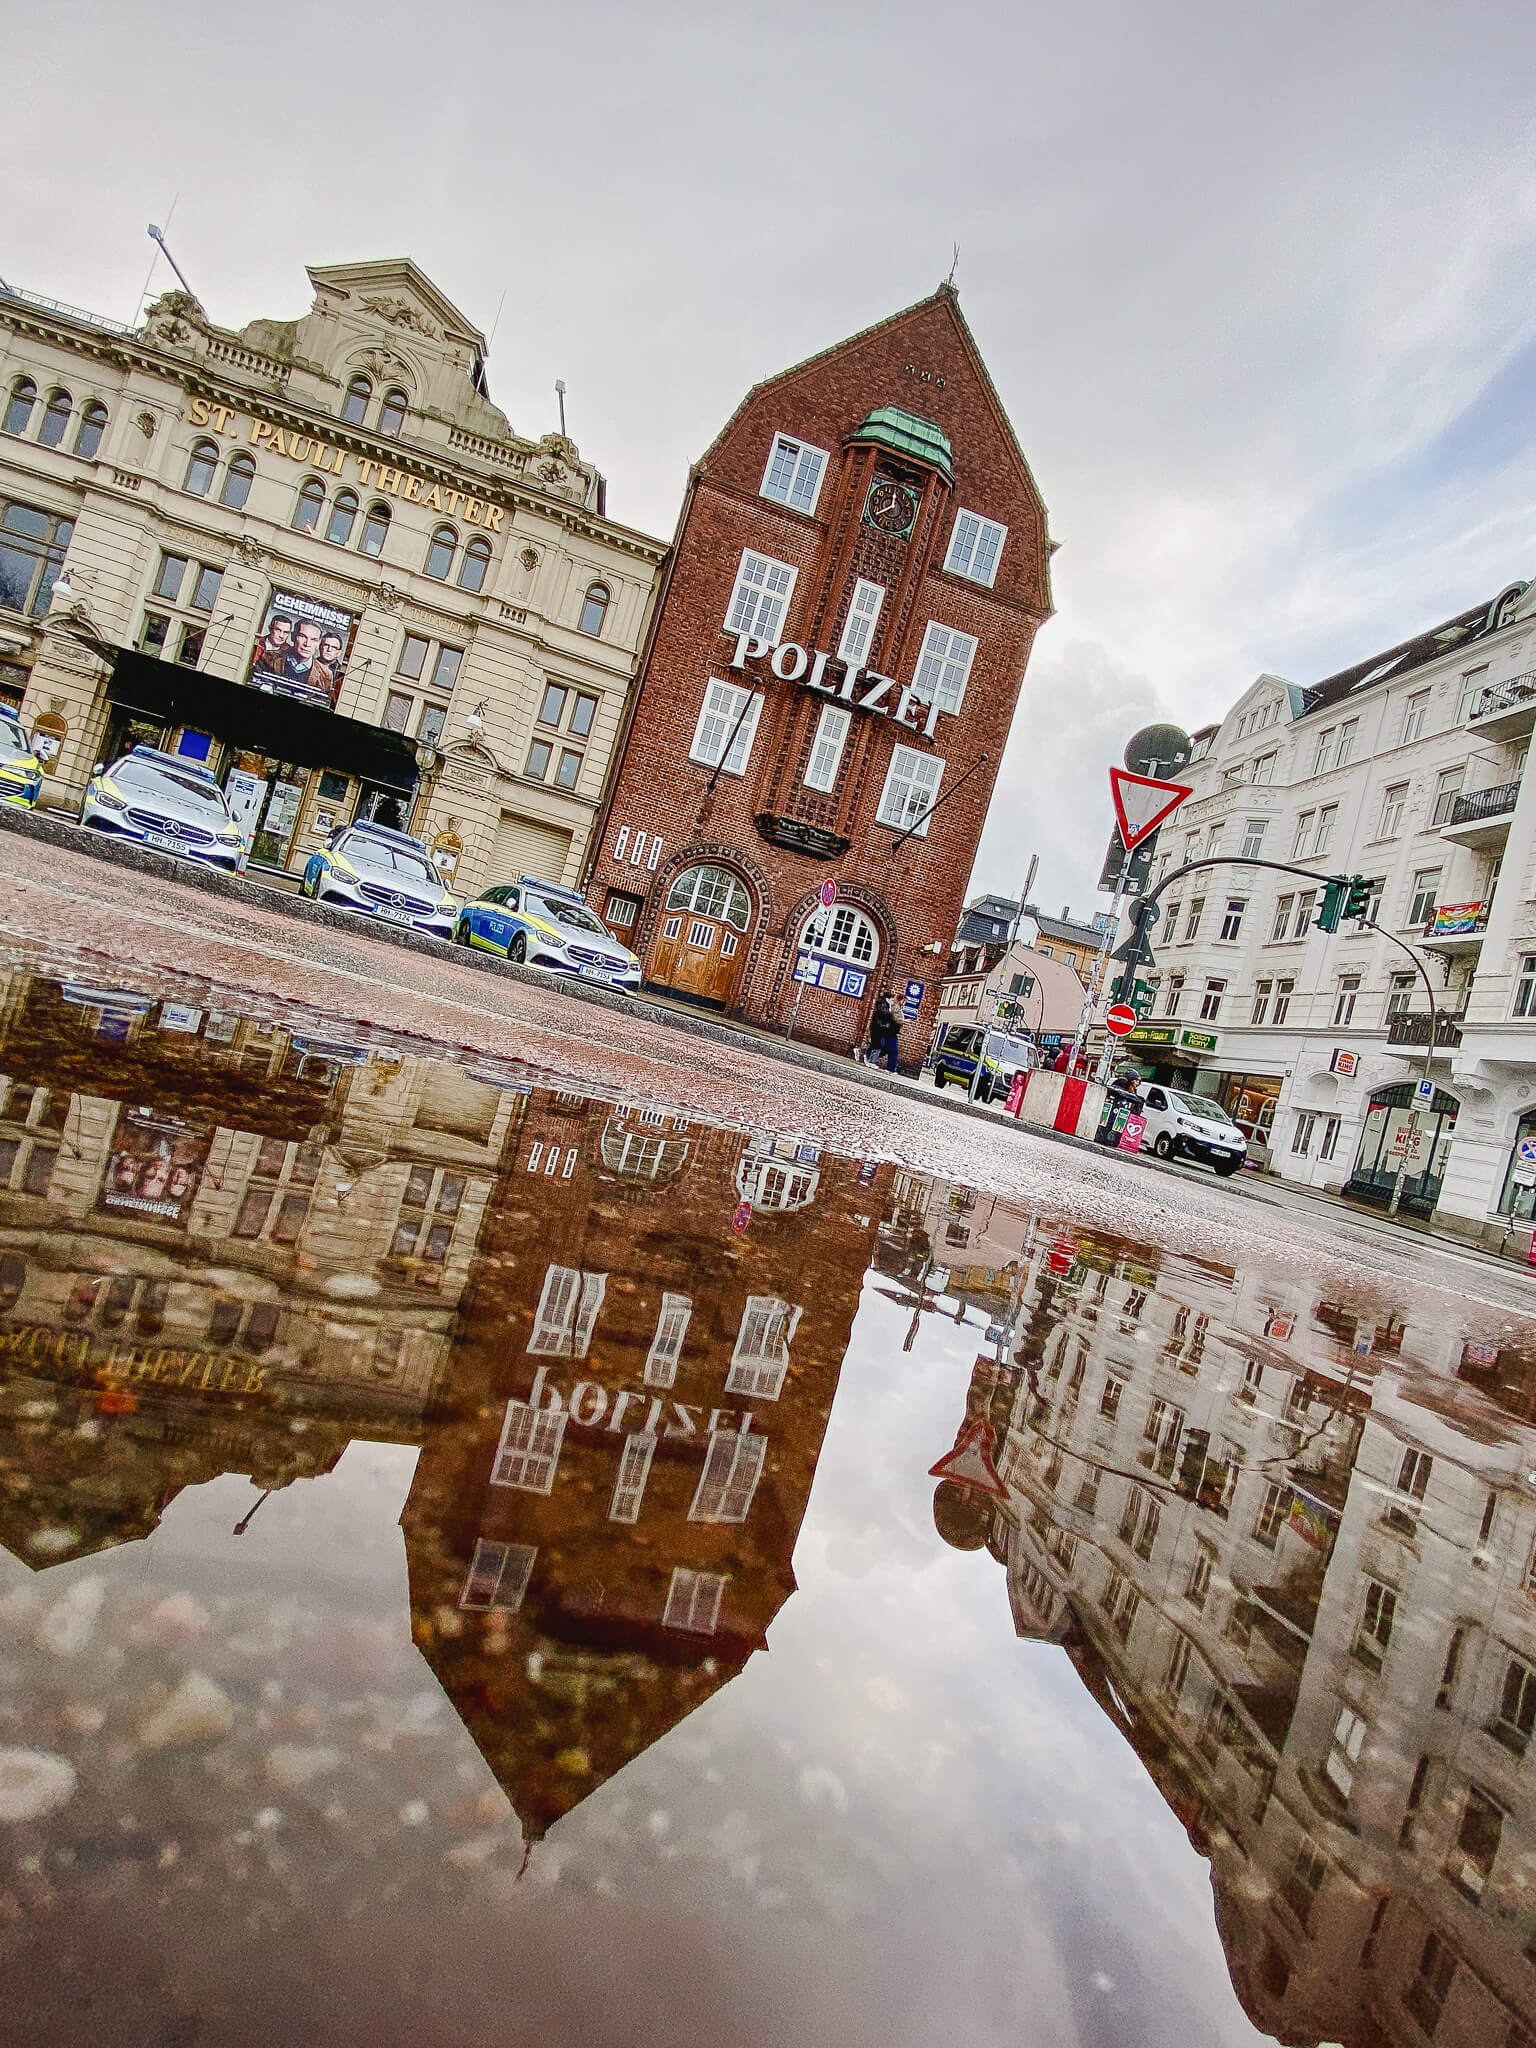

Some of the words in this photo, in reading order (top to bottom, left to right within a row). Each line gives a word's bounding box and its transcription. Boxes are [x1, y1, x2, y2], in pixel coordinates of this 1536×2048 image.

[187, 397, 237, 438] ST.
[248, 418, 349, 476] PAULI
[356, 455, 506, 533] THEATER
[275, 593, 351, 627] GEHEIMNISSE
[728, 633, 943, 741] POLIZEI
[380, 906, 391, 916] HH
[1189, 1032, 1211, 1043] Salon
[1421, 1081, 1431, 1093] P
[1395, 1134, 1421, 1147] KIG
